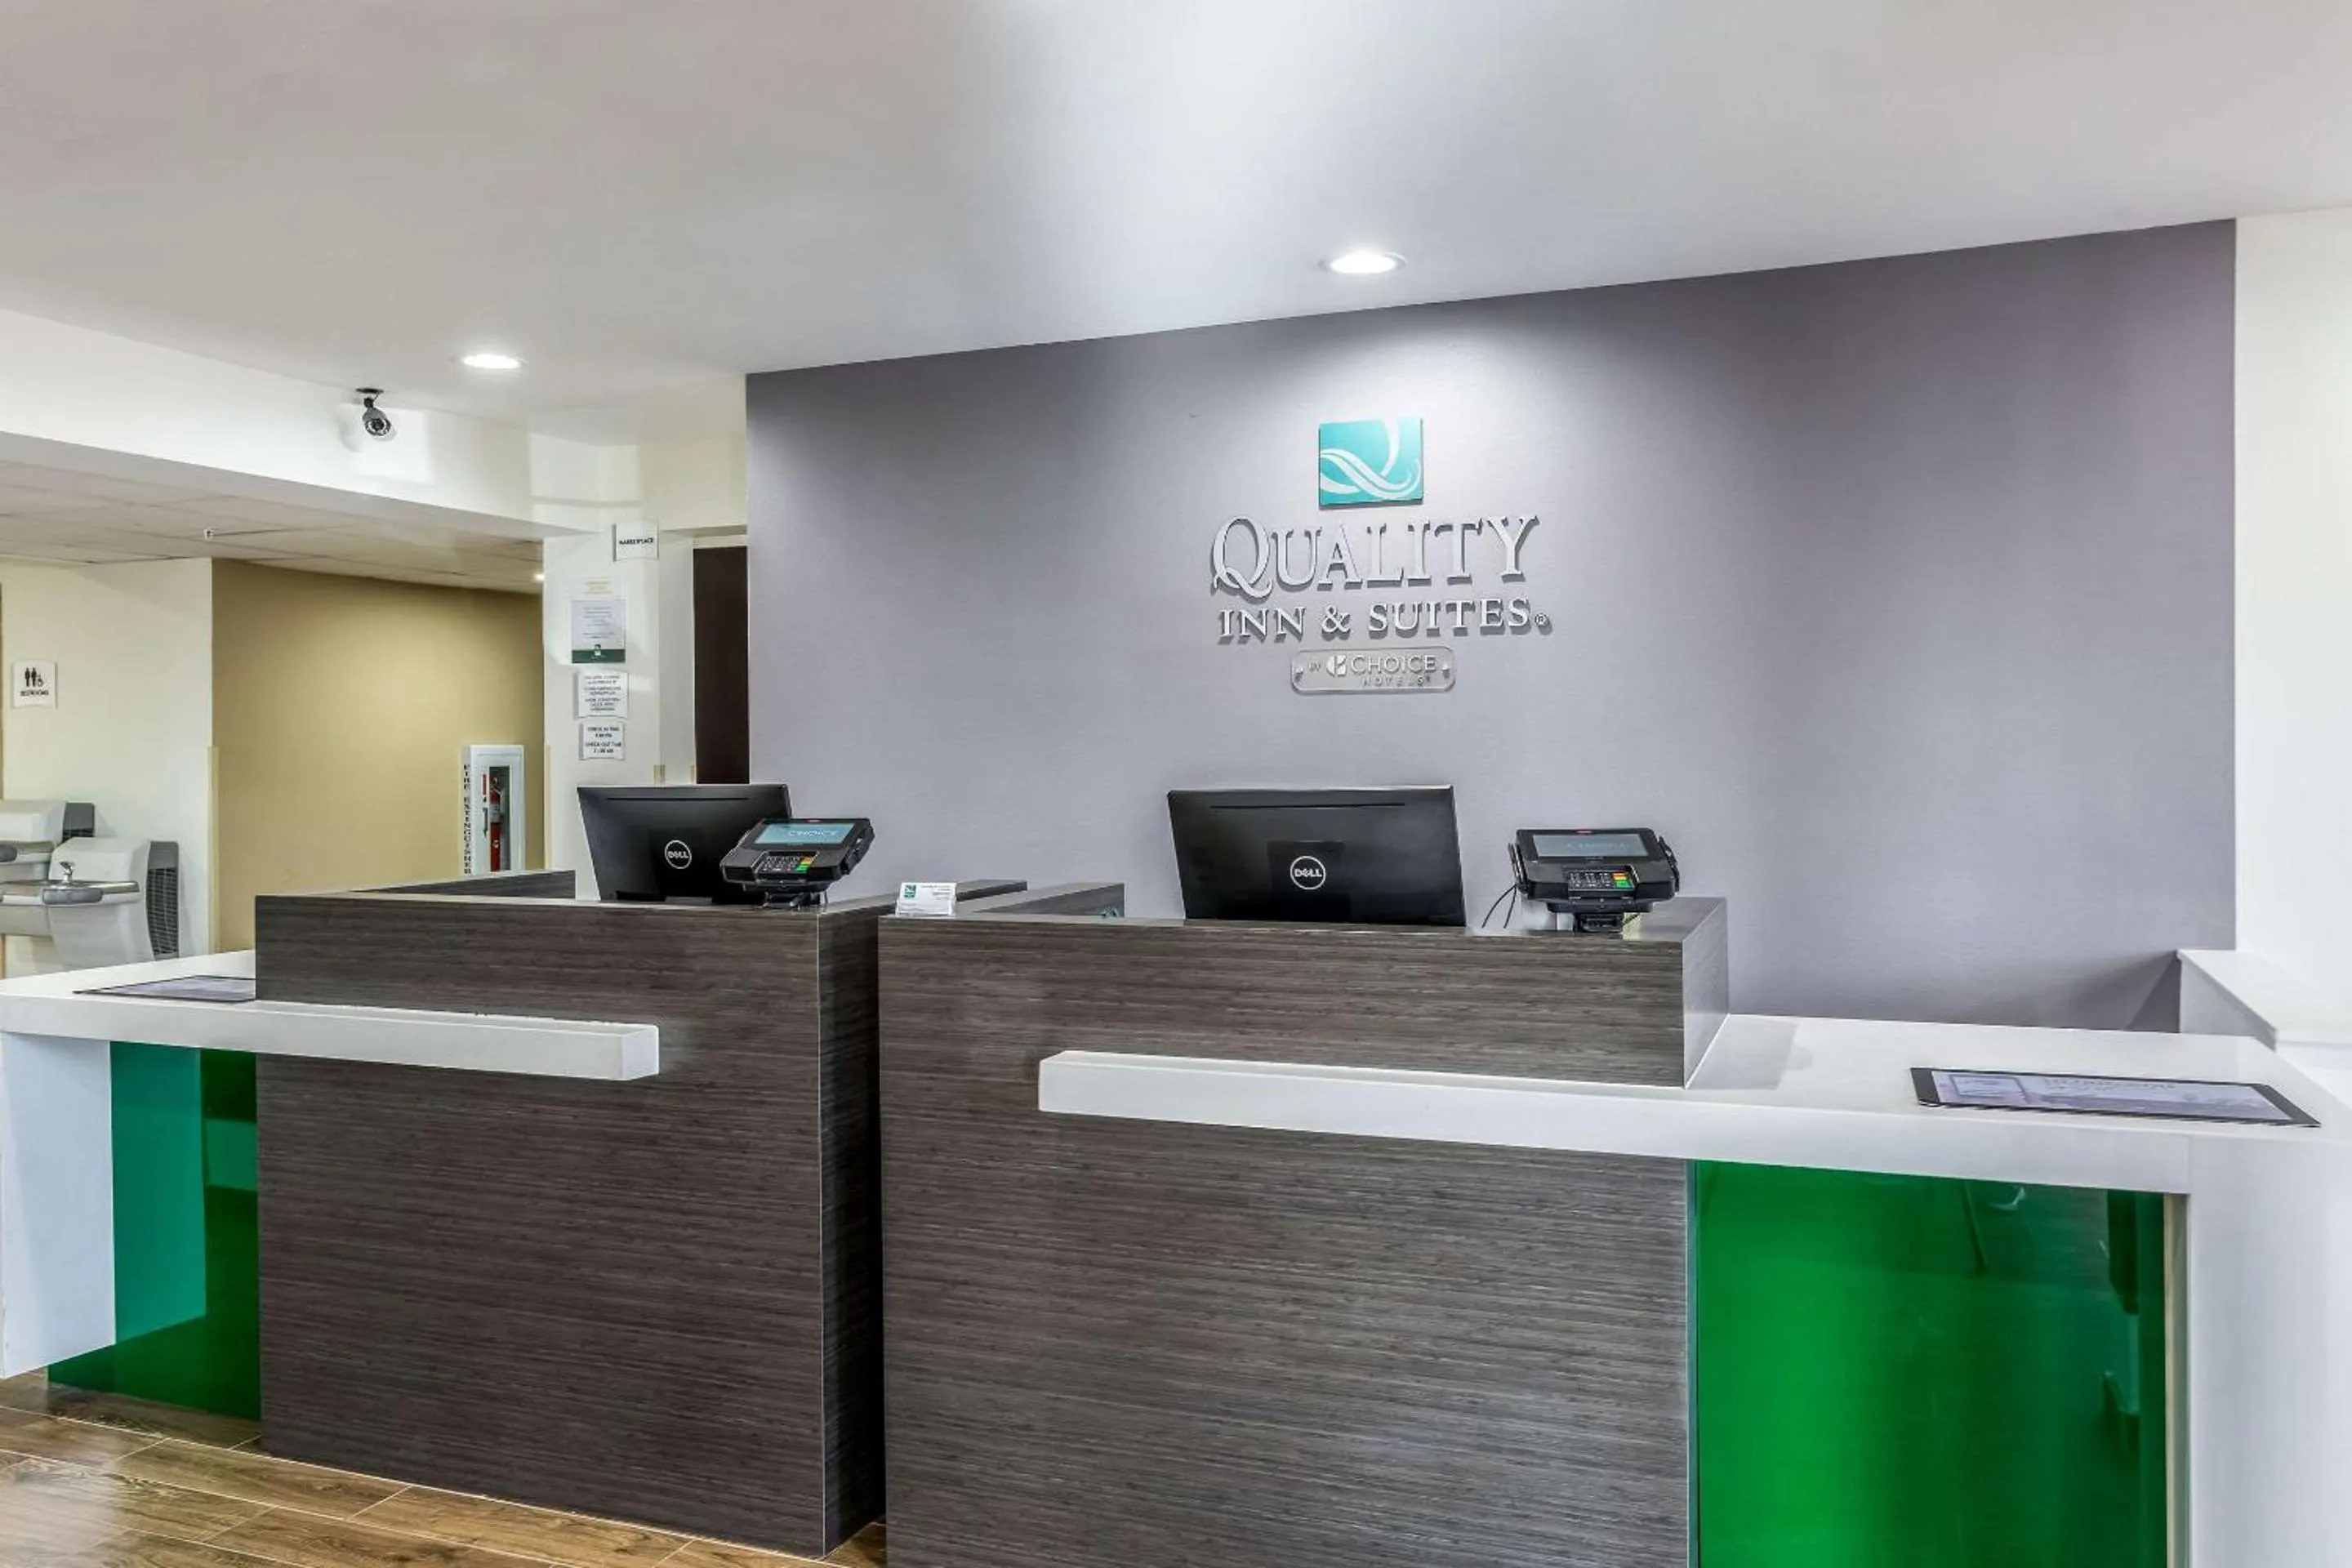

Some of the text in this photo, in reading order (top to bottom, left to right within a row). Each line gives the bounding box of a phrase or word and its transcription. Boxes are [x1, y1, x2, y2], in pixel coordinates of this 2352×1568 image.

[1213, 515, 1539, 599] QUALITY
[1221, 606, 1306, 637] INN
[1321, 606, 1352, 634] &
[1351, 654, 1437, 673] CHOICE
[1294, 868, 1323, 877] DELL
